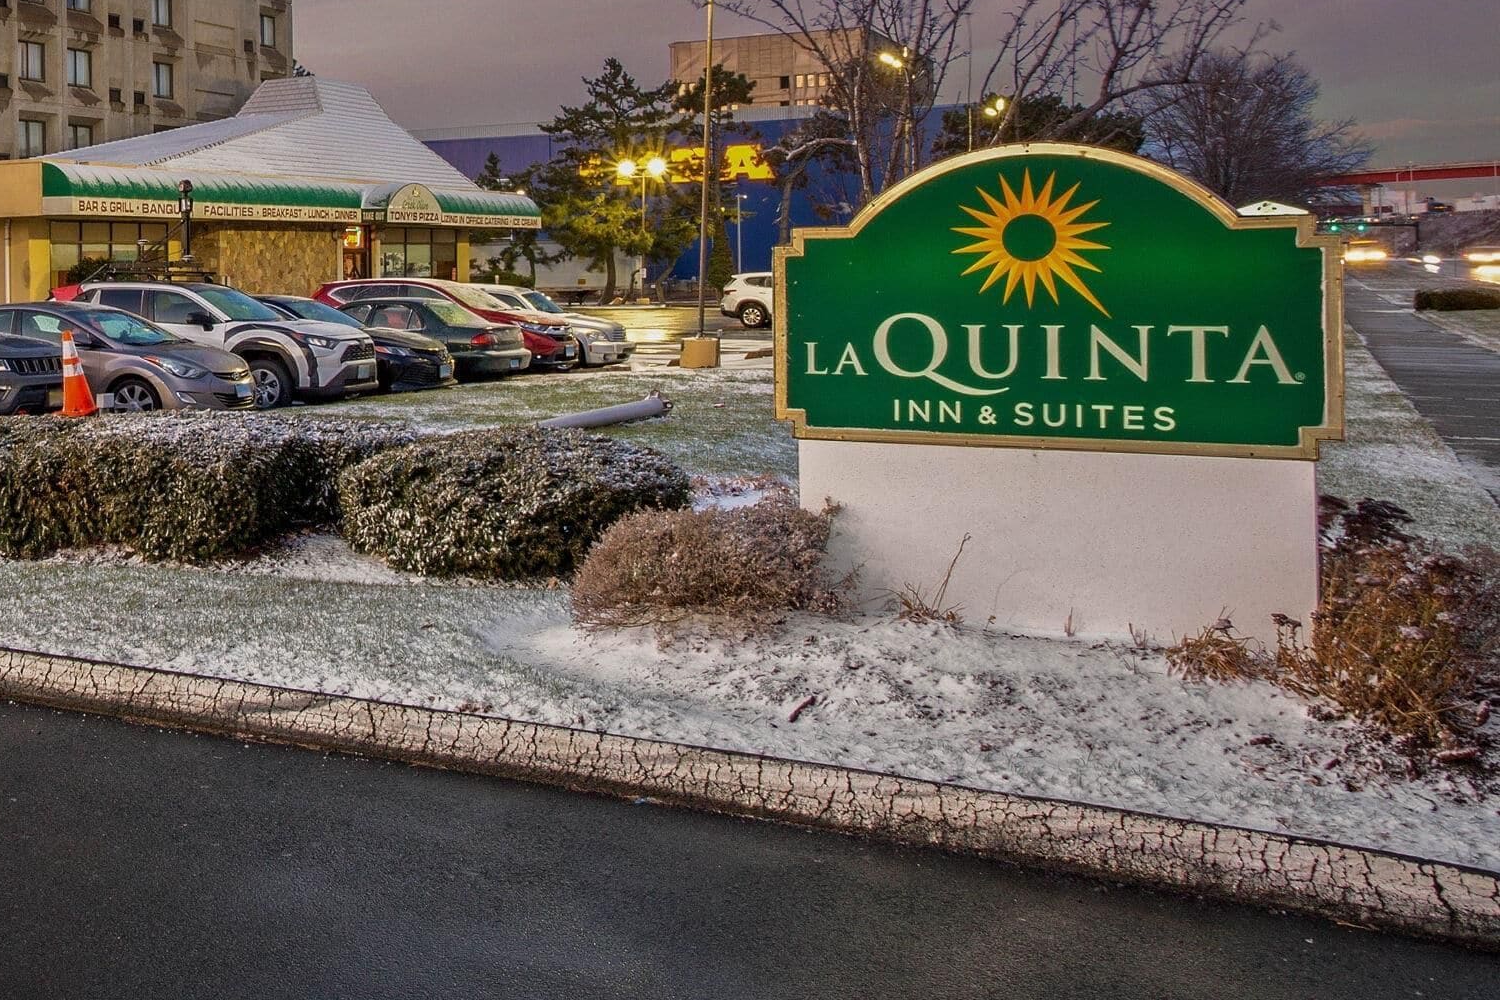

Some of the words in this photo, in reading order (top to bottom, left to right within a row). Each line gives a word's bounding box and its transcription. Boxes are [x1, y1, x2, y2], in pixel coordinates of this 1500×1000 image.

[79, 200, 99, 212] BAR
[100, 201, 108, 212] &
[109, 201, 134, 213] GRILL
[142, 203, 182, 215] BANQU
[203, 205, 254, 217] FACILITIES
[262, 207, 303, 219] BREAKFAST
[308, 208, 330, 219] LUNCH
[335, 209, 358, 220] DINNER
[390, 211, 418, 221] TONY'S
[419, 212, 440, 221] PIZZA
[459, 215, 465, 224] IN
[465, 216, 484, 225] OFFICE
[484, 217, 509, 226] CATERING
[521, 218, 538, 226] CREAM
[804, 341, 869, 376] LA
[871, 312, 1304, 397] QUINTA
[893, 398, 962, 425] INN
[978, 405, 997, 426] &
[1013, 402, 1177, 432] SUITES
